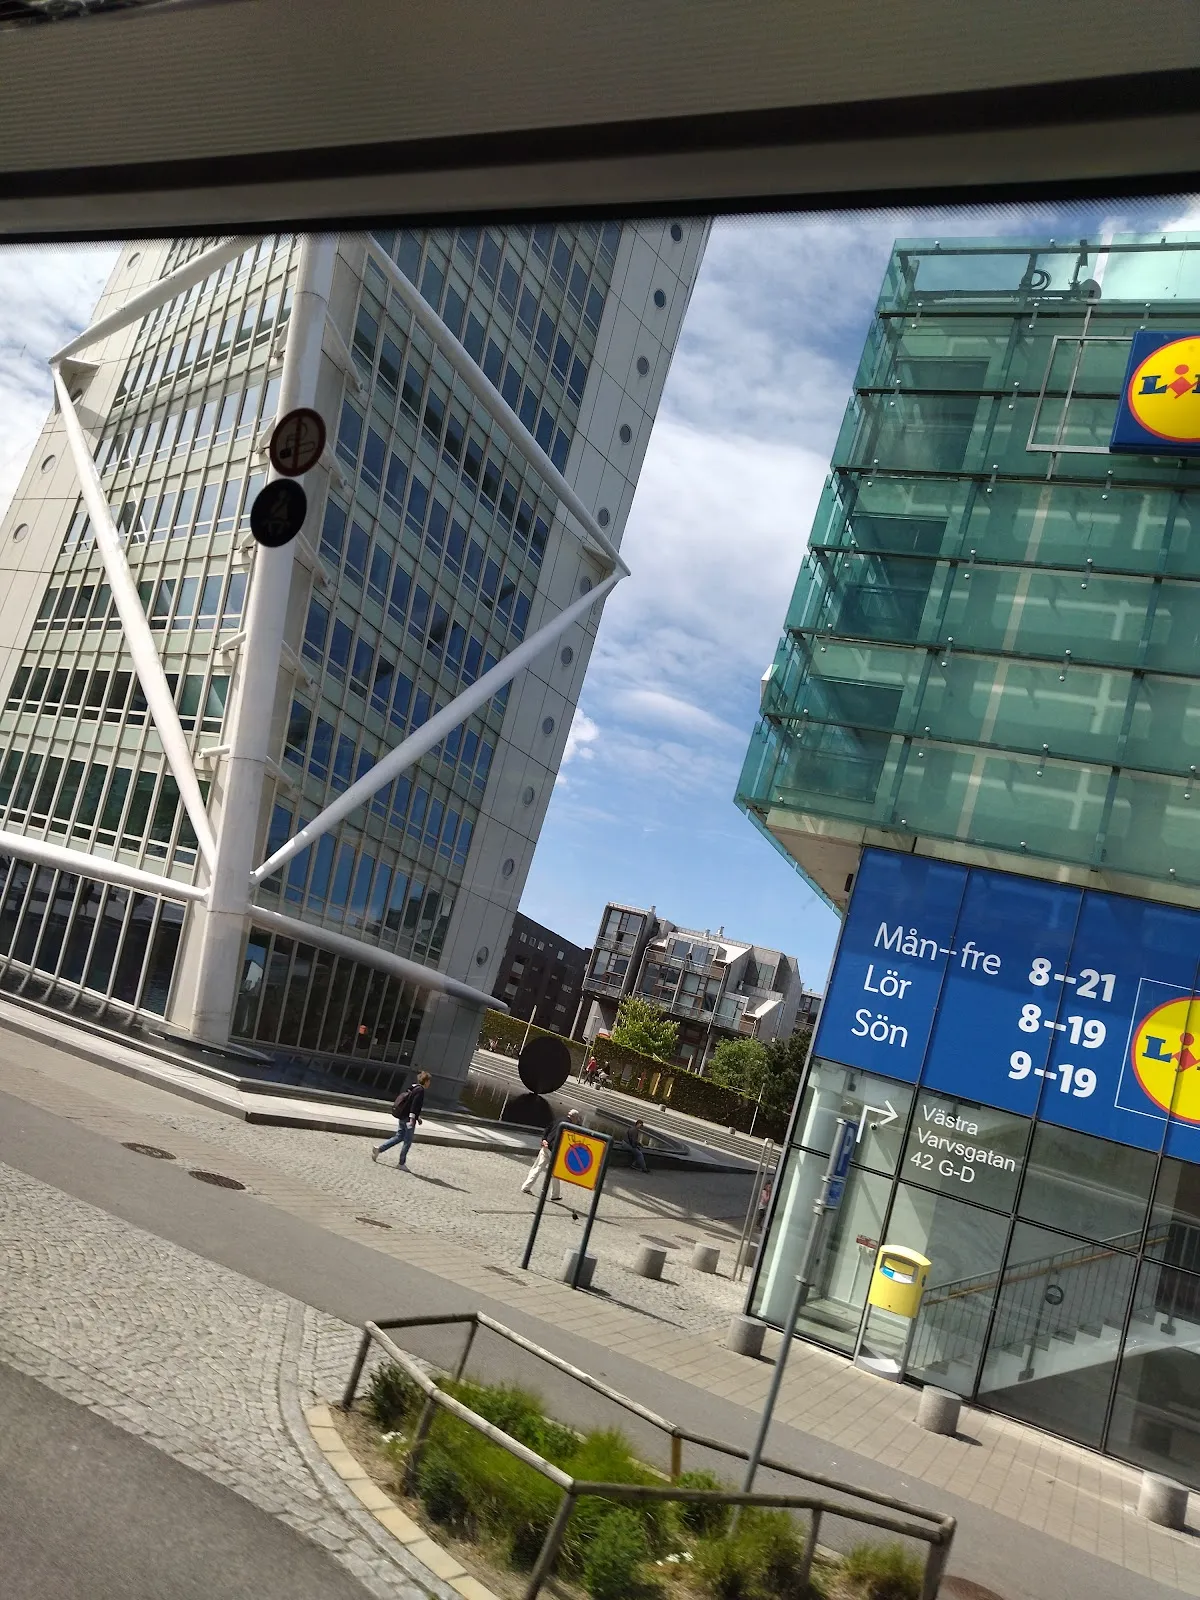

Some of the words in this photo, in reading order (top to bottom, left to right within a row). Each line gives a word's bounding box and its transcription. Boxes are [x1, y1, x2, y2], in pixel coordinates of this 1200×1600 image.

[1138, 364, 1200, 399] Li
[863, 964, 912, 1000] Lör
[850, 1008, 909, 1048] Sön
[922, 1104, 979, 1136] Västra
[917, 1126, 1016, 1172] Varvsgatan
[910, 1151, 934, 1171] 42
[938, 1159, 975, 1183] G-D
